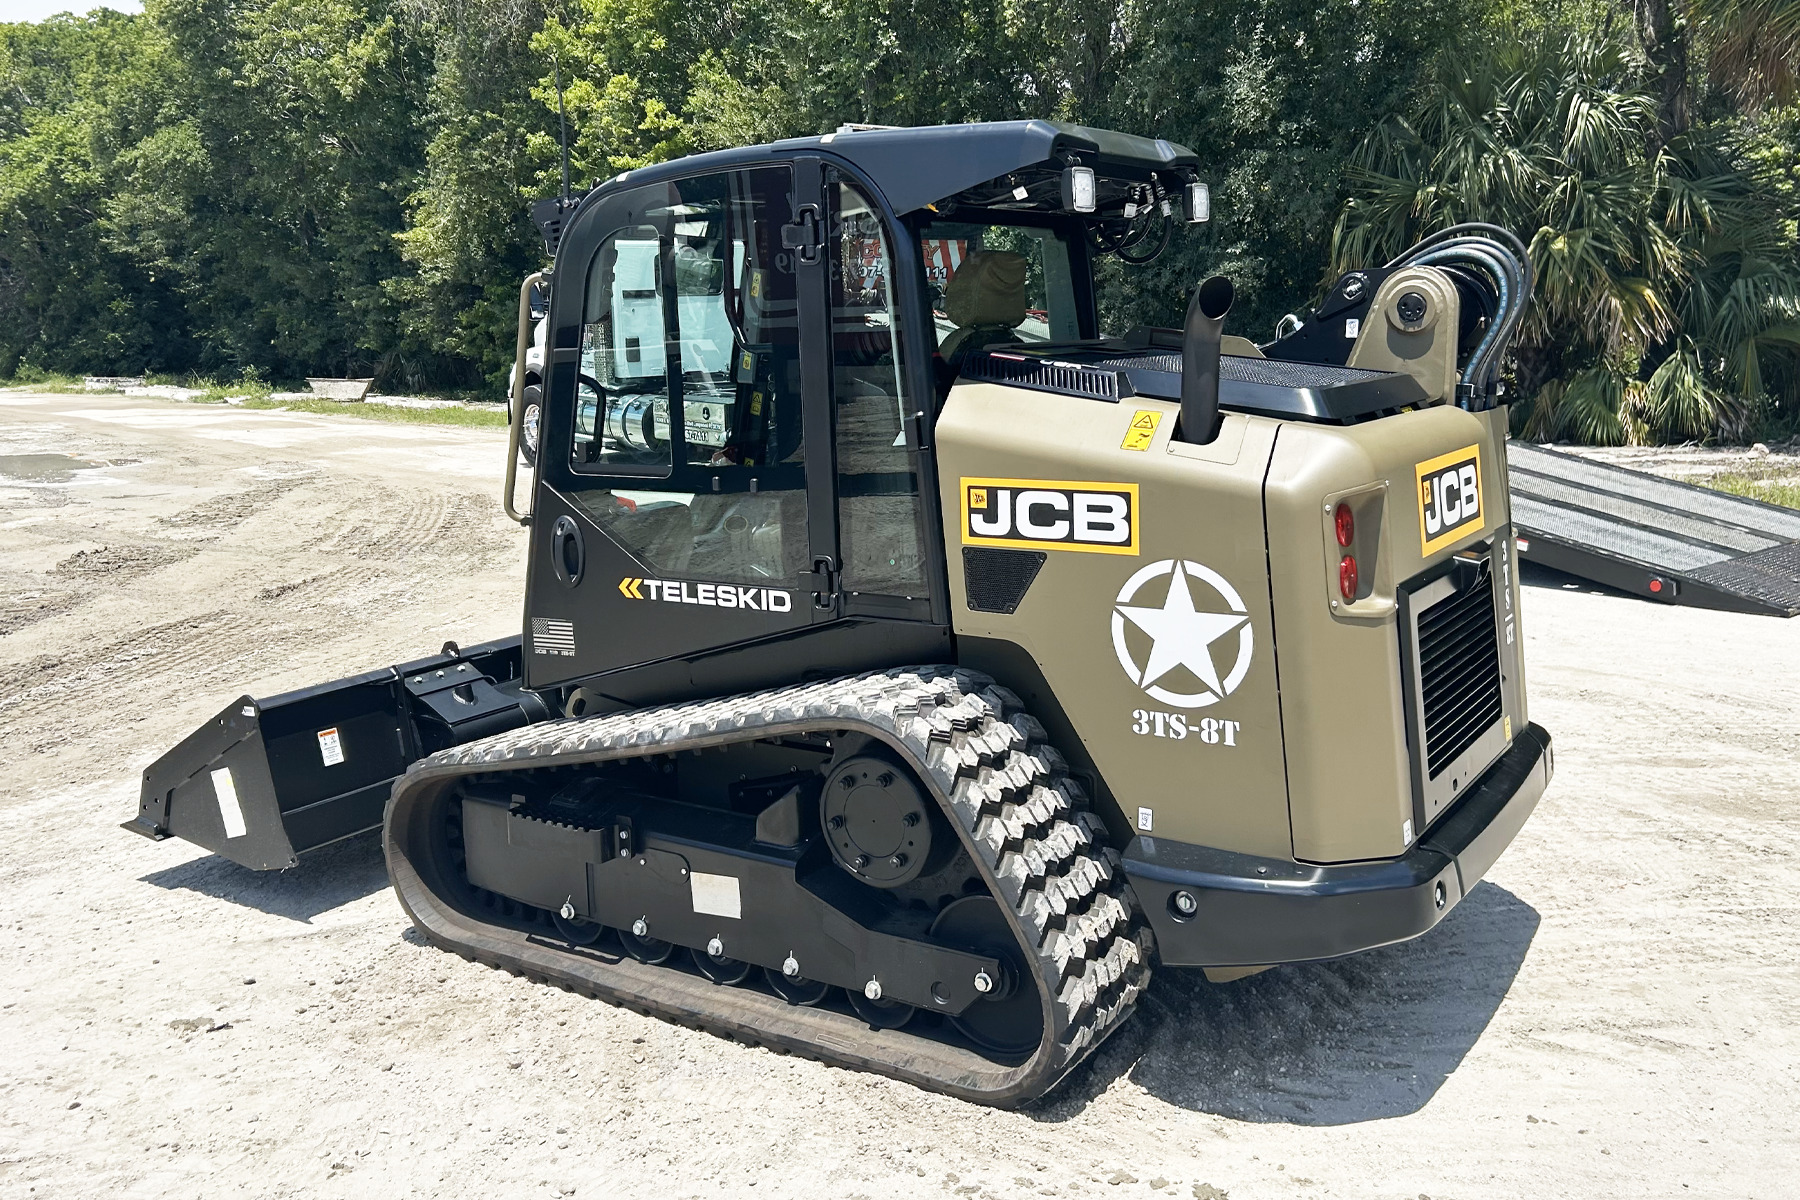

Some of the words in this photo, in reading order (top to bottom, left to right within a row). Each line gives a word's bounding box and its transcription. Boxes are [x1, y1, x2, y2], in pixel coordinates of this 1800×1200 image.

[970, 489, 1130, 543] JCB
[1425, 464, 1479, 534] JCB
[643, 579, 793, 613] TELESKID
[1131, 708, 1241, 747] 3TS-8T
